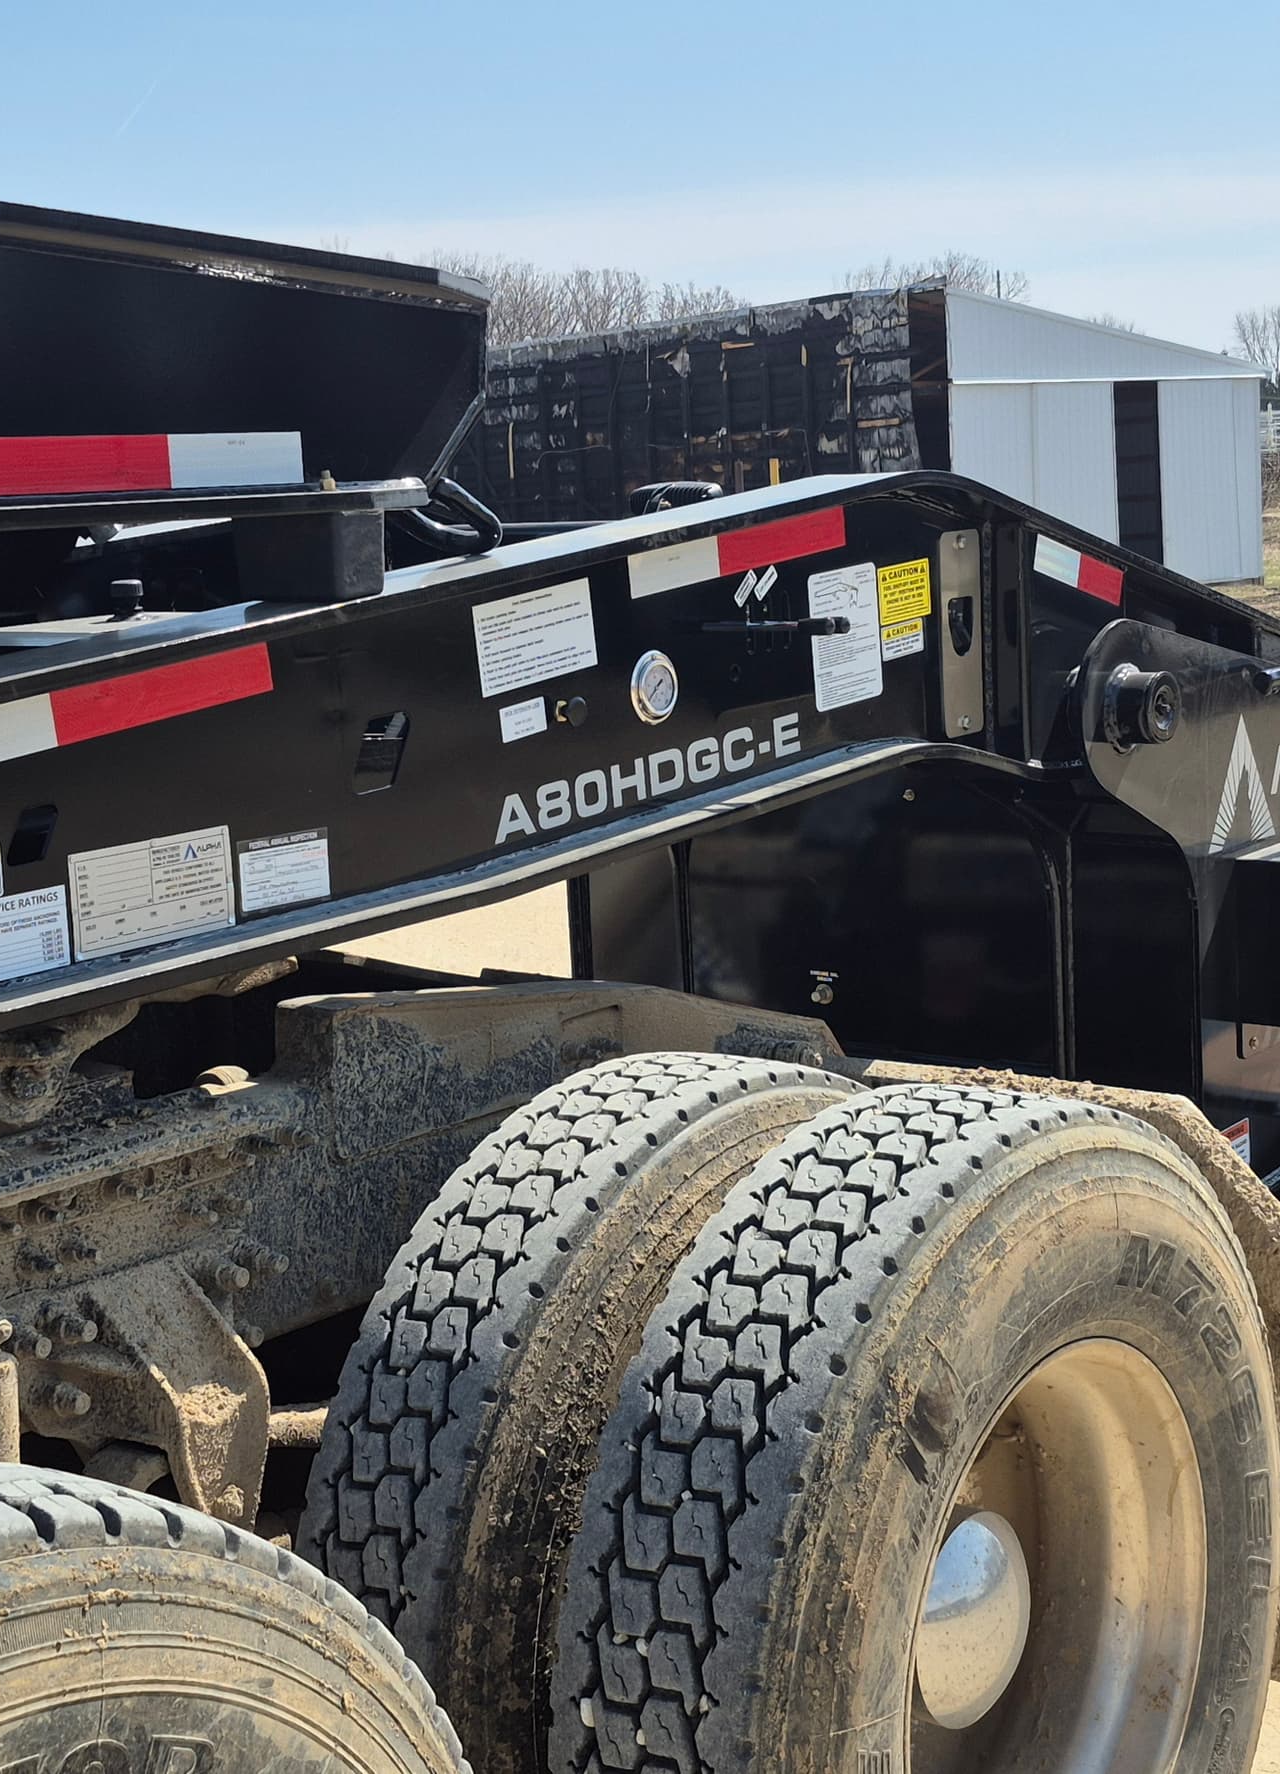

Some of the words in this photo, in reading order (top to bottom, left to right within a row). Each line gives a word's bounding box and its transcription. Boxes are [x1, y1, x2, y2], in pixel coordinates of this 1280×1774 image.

[888, 567, 918, 580] CAUTION
[892, 623, 918, 637] CAUTION
[494, 712, 801, 845] A80HDGC-E
[196, 841, 222, 852] ALPHA
[18, 892, 58, 909] RATINGS
